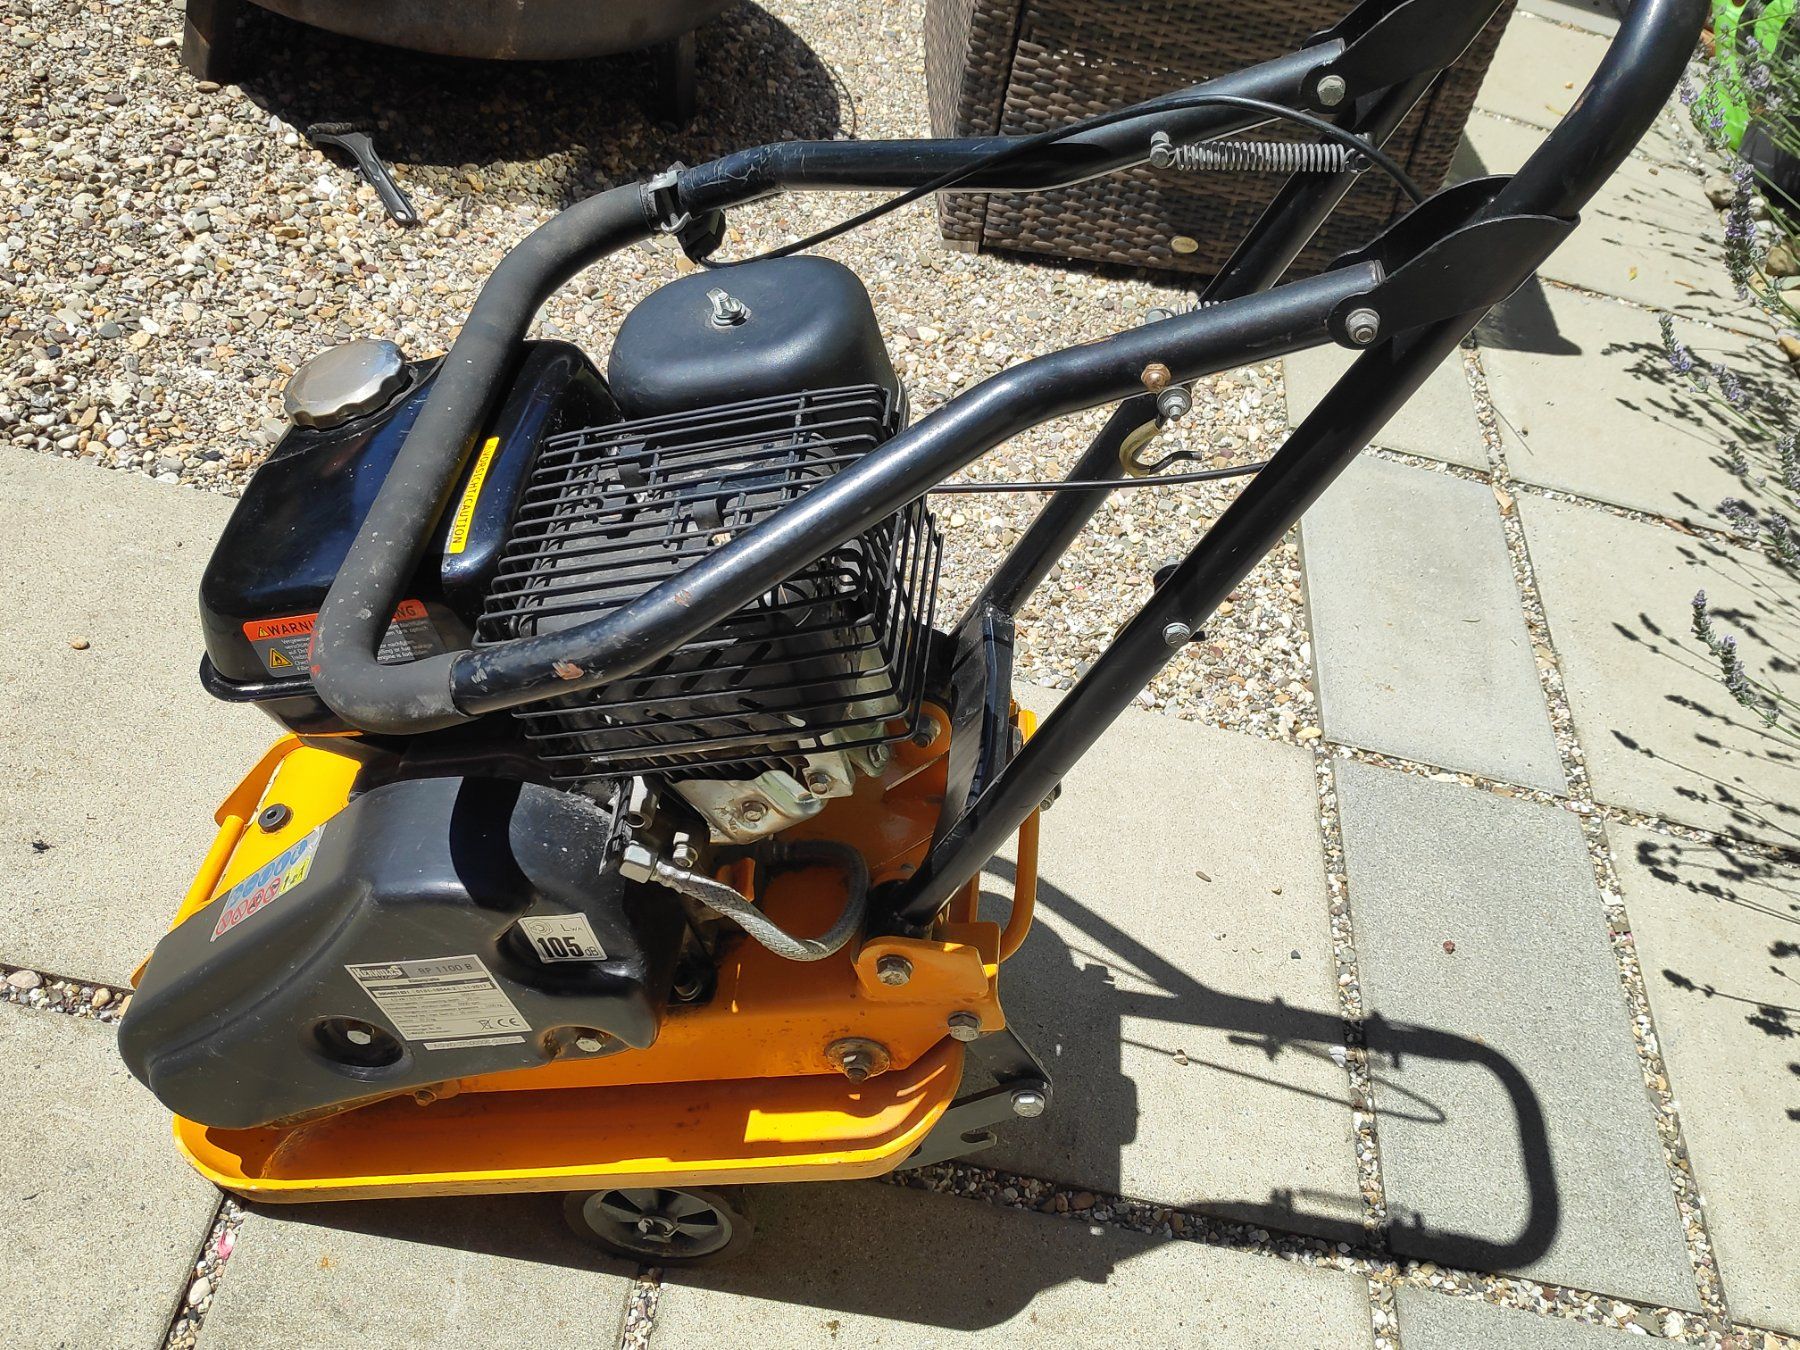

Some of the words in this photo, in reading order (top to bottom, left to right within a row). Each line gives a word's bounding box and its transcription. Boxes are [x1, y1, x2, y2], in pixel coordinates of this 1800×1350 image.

[537, 936, 584, 958] 105
[584, 946, 599, 956] dB
[437, 963, 462, 973] 1100
